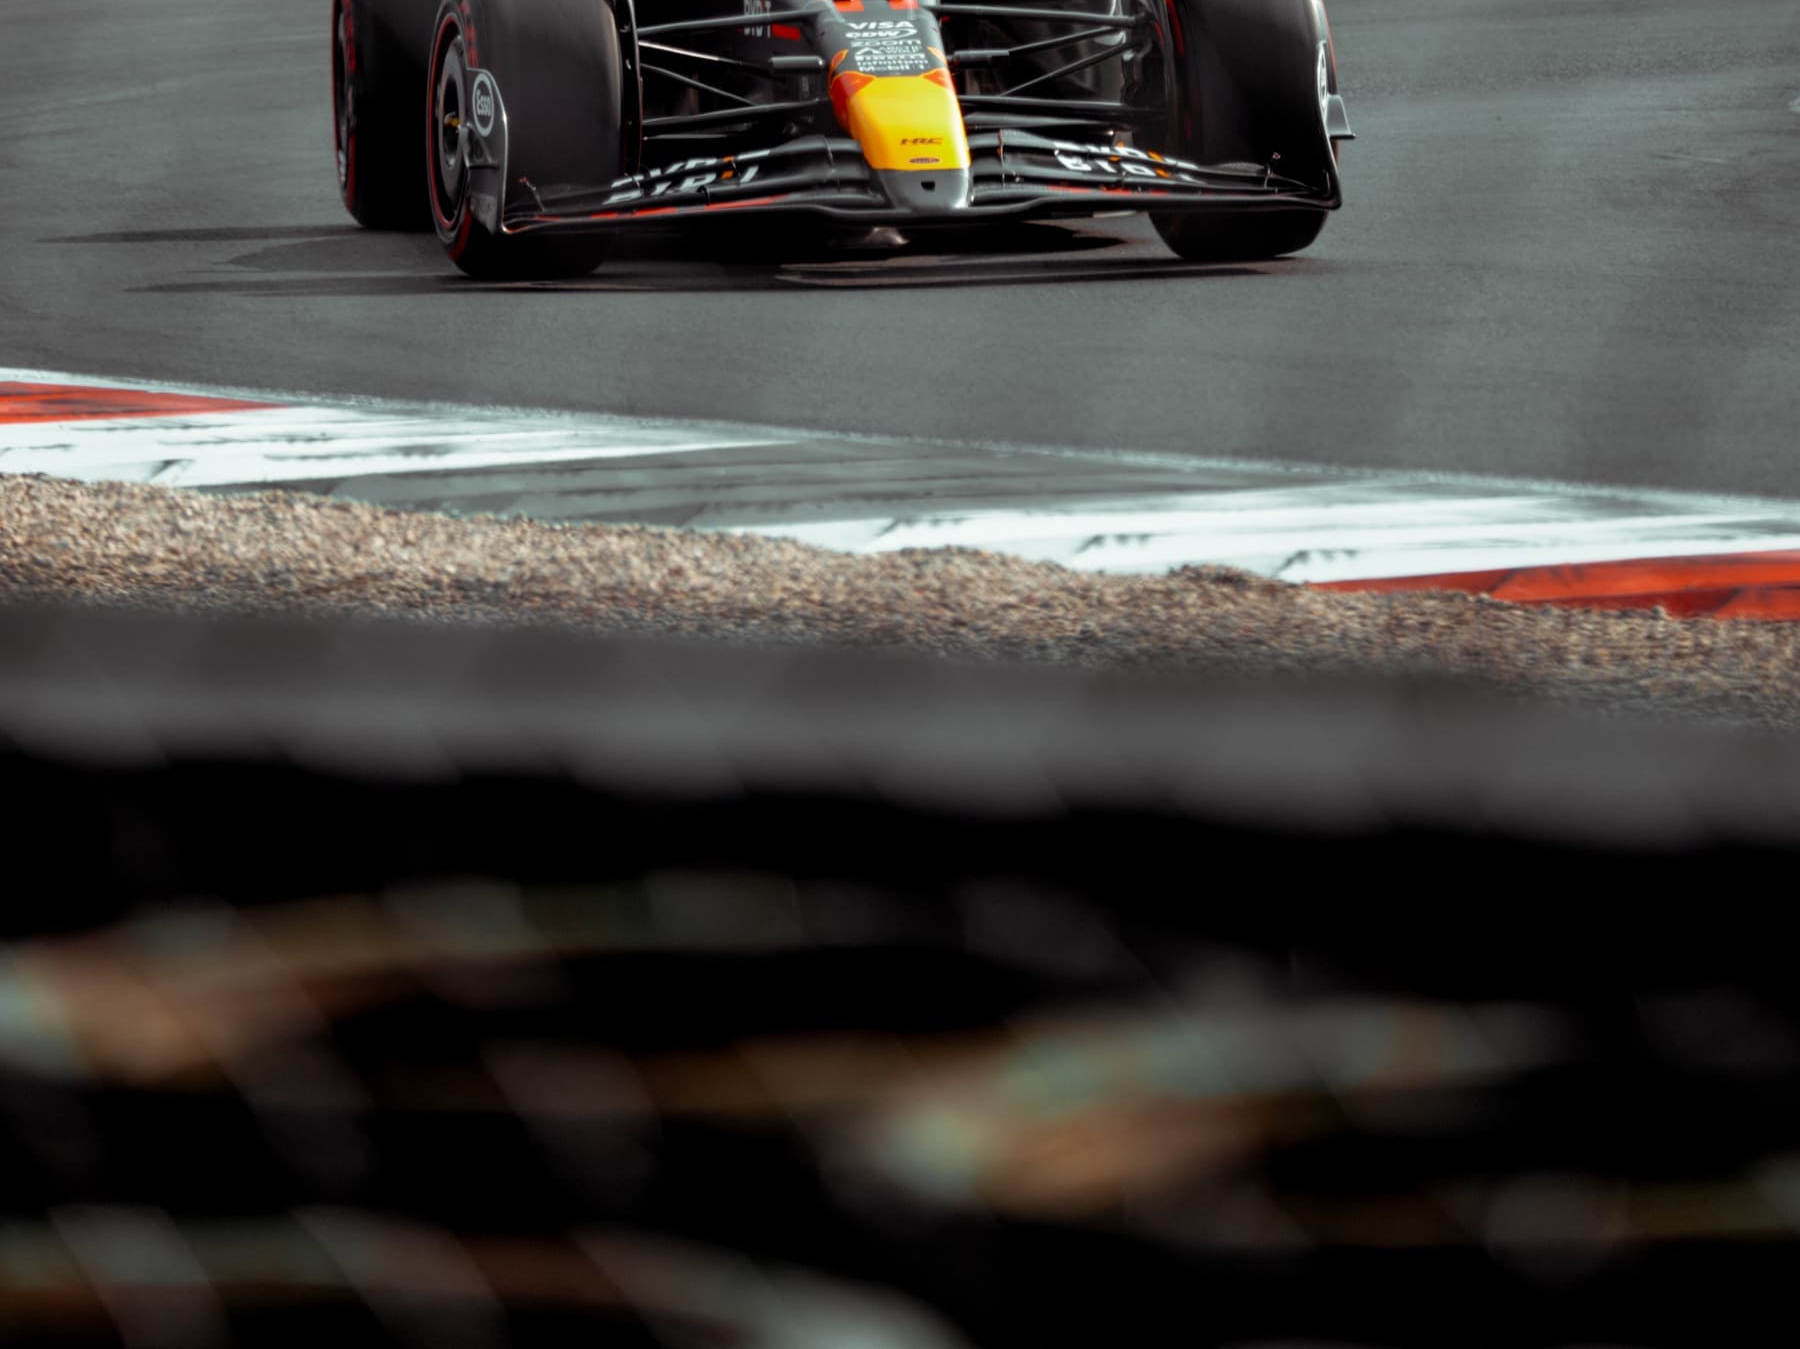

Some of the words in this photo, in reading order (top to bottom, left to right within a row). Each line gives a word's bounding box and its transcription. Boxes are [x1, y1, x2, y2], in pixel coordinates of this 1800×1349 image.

[848, 21, 914, 29] VISA
[851, 39, 921, 47] zoom
[476, 89, 492, 117] Esso
